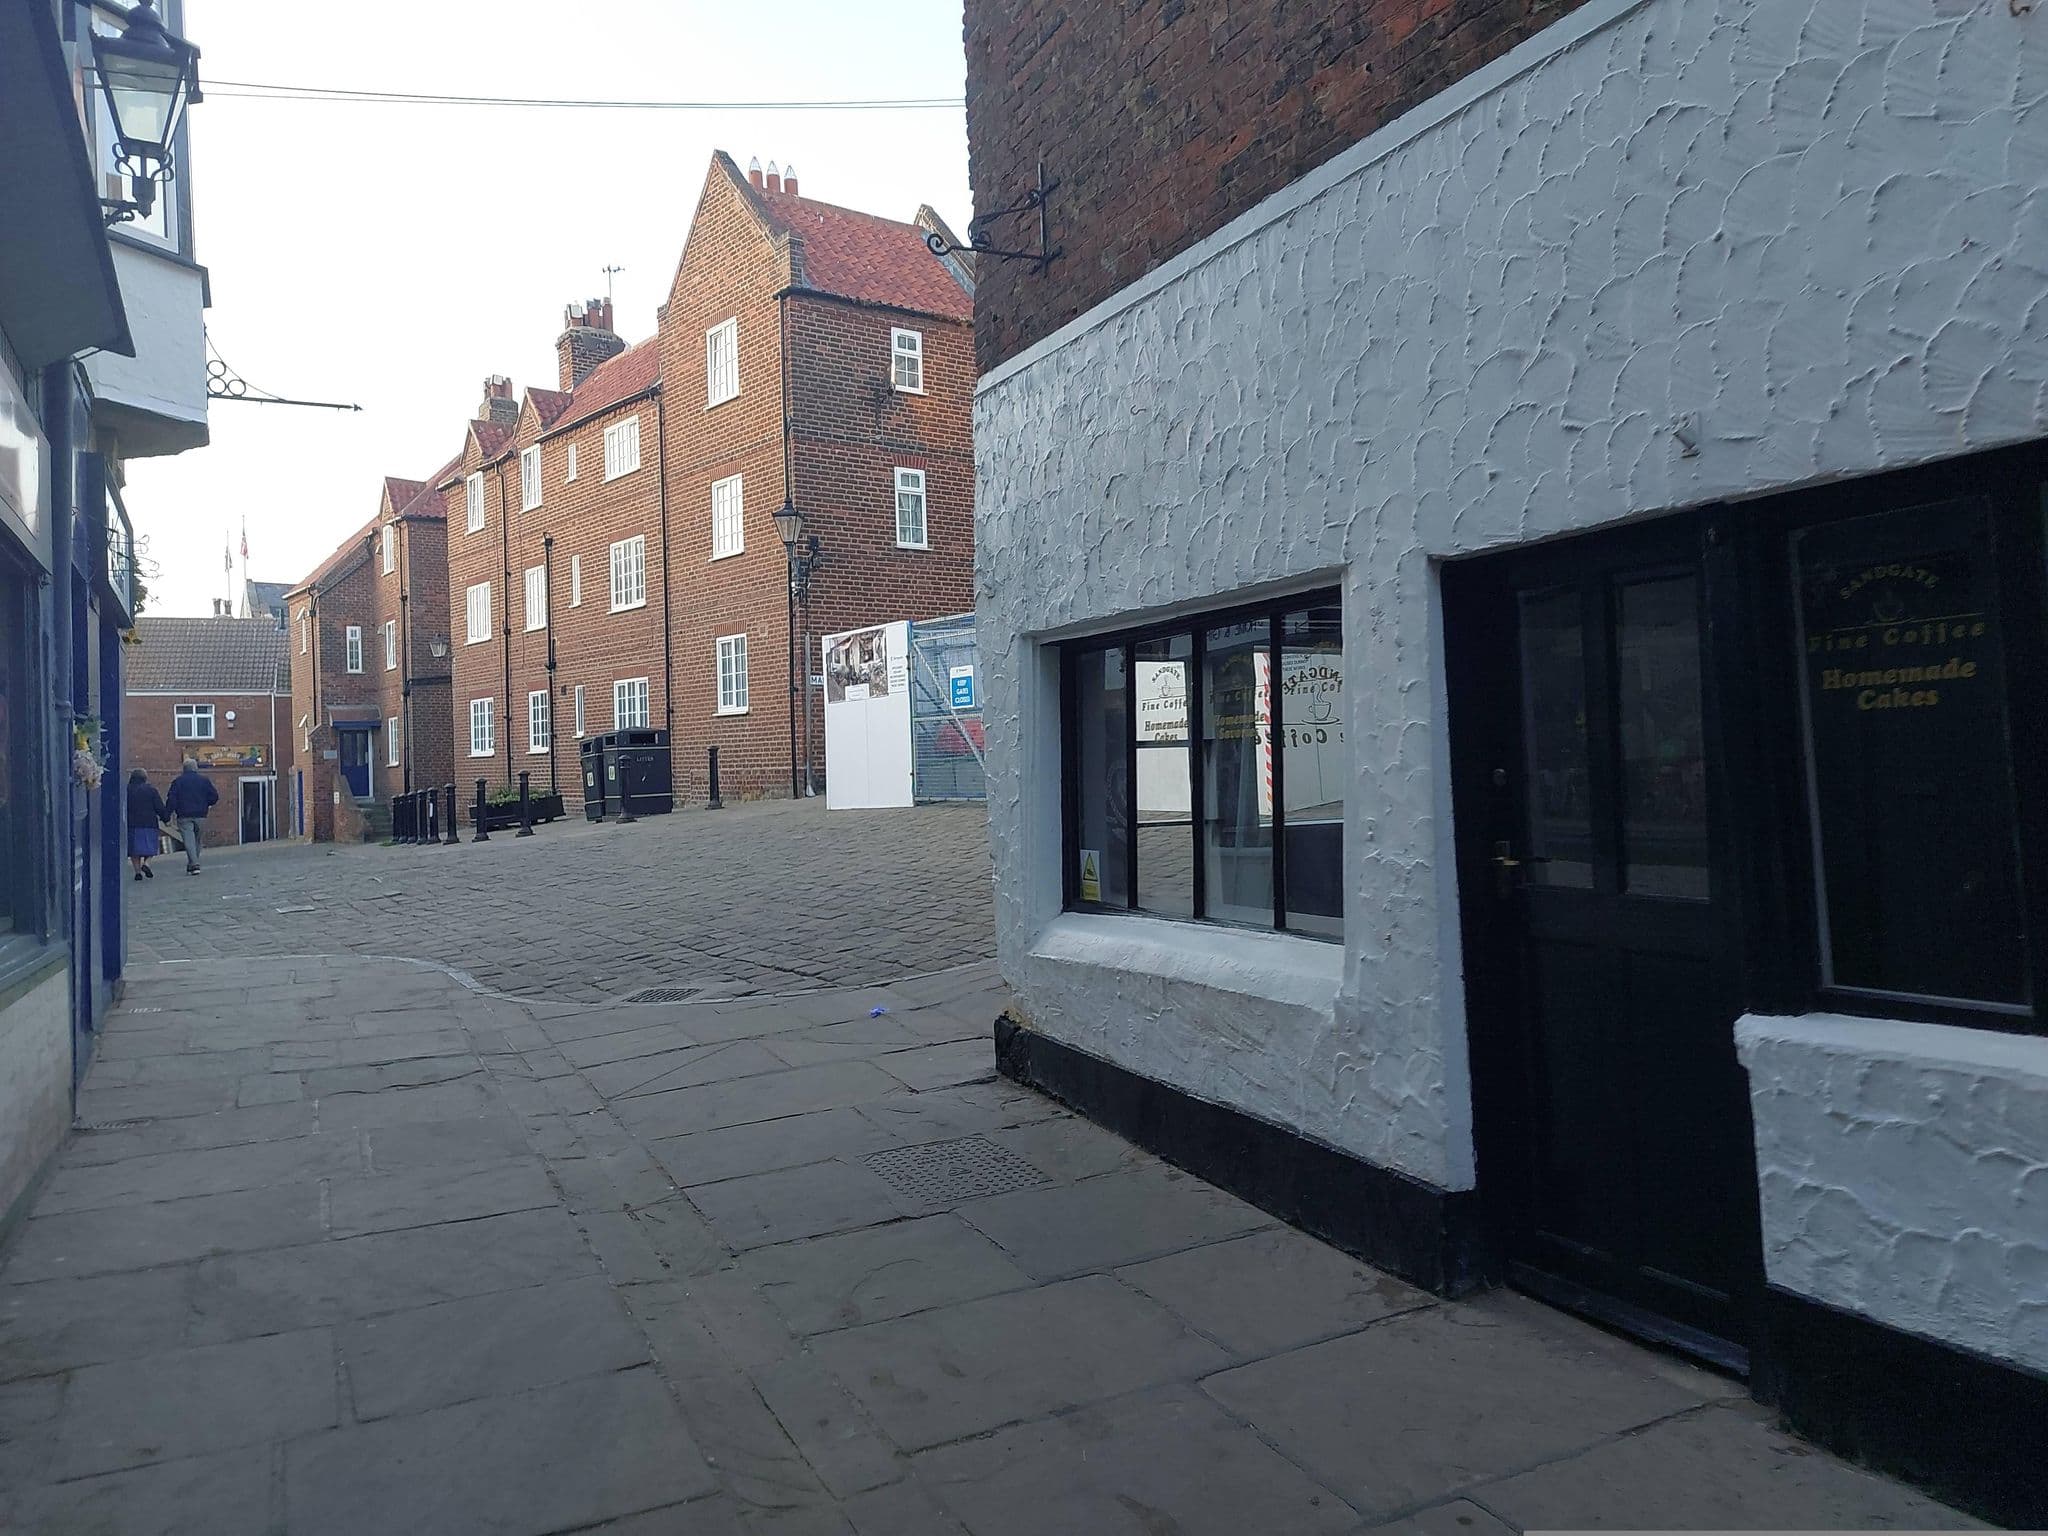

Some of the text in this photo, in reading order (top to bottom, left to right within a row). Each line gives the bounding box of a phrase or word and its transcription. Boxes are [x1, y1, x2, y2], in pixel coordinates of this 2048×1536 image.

[1807, 621, 1985, 653] Fine Coffee
[1822, 657, 1978, 690] Homemade
[1321, 679, 1343, 693] Cof
[1141, 698, 1189, 712] Fine Coffe
[1857, 687, 1938, 711] Cakes
[1144, 717, 1189, 732] Homemade
